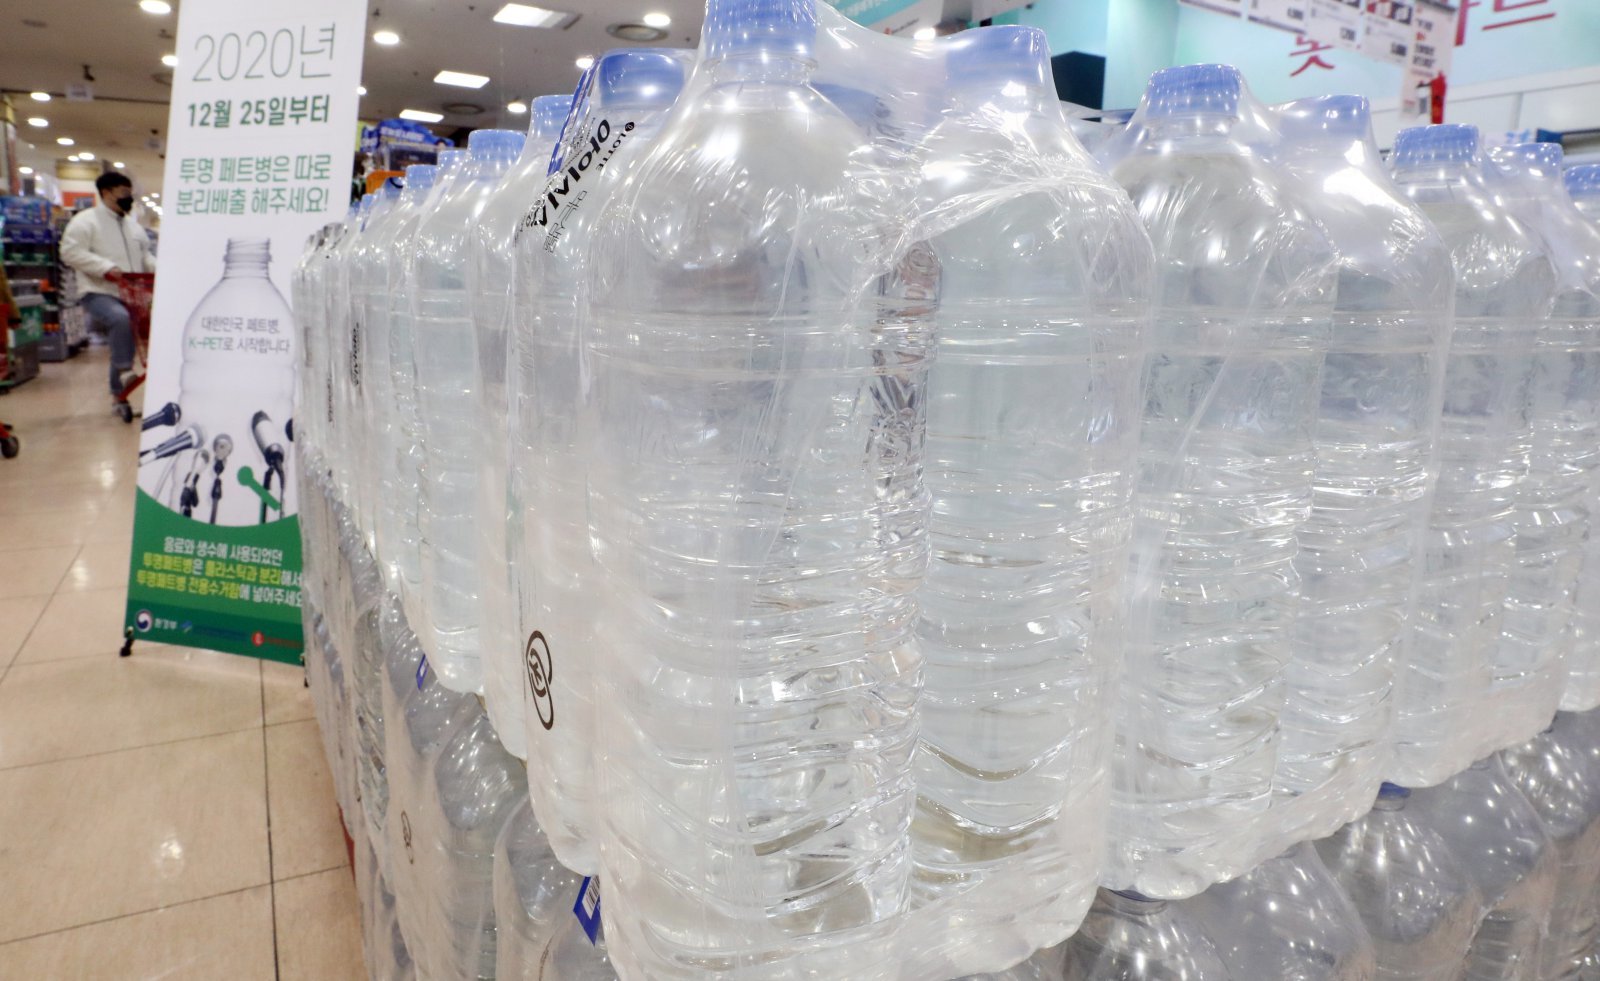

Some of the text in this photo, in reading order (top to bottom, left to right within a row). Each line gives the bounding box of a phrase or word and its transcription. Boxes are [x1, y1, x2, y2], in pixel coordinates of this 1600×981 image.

[192, 22, 336, 82] 2020년
[188, 94, 330, 129] 12월 25일부터
[596, 133, 627, 172] LOTTE
[179, 154, 332, 184] 투명 페트병은 따로
[177, 187, 330, 216] 분리배출 해주세요!
[201, 317, 243, 332] 대한민국
[188, 336, 291, 354] K-PET로 시작합니다
[164, 536, 195, 555] 음료와
